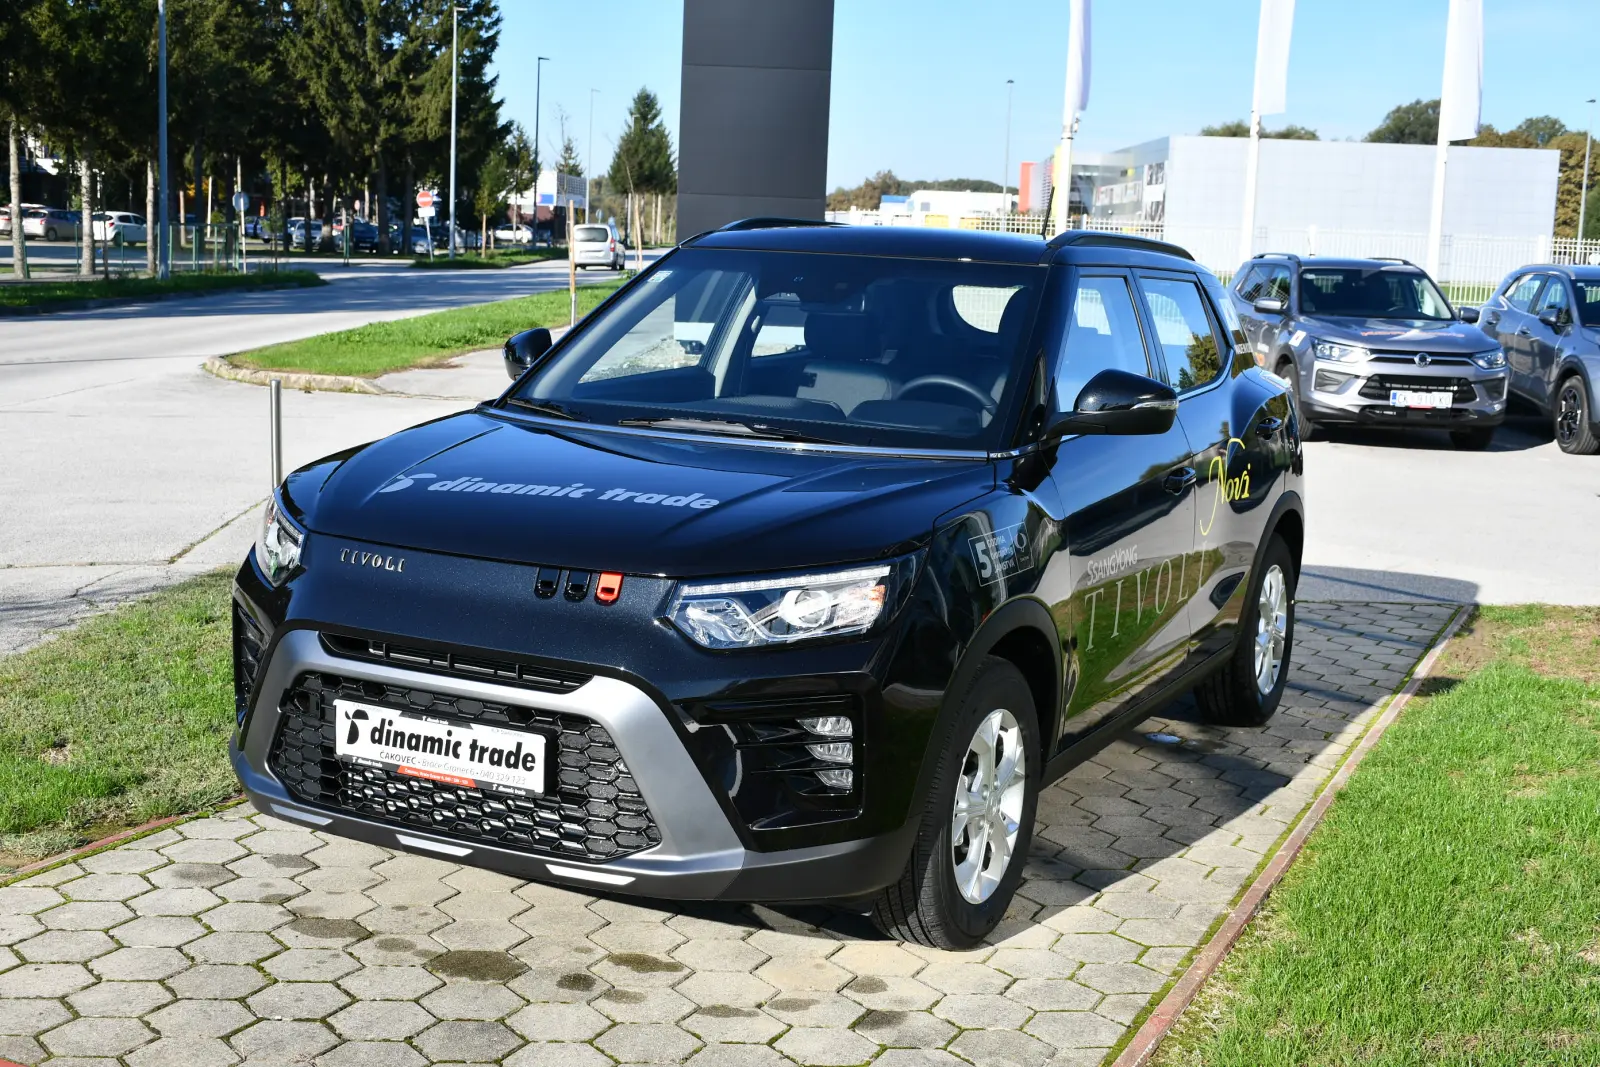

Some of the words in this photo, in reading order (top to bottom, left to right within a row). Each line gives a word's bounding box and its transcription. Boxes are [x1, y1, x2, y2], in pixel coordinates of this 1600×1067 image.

[427, 477, 595, 498] dinamic
[597, 487, 720, 509] trade
[1199, 437, 1251, 536] Novi
[340, 548, 405, 572] TIVOLI
[975, 541, 992, 578] 5
[1084, 540, 1208, 652] TIVOLI
[370, 717, 462, 760] dinamic
[469, 738, 536, 772] trade
[512, 775, 526, 786] 123
